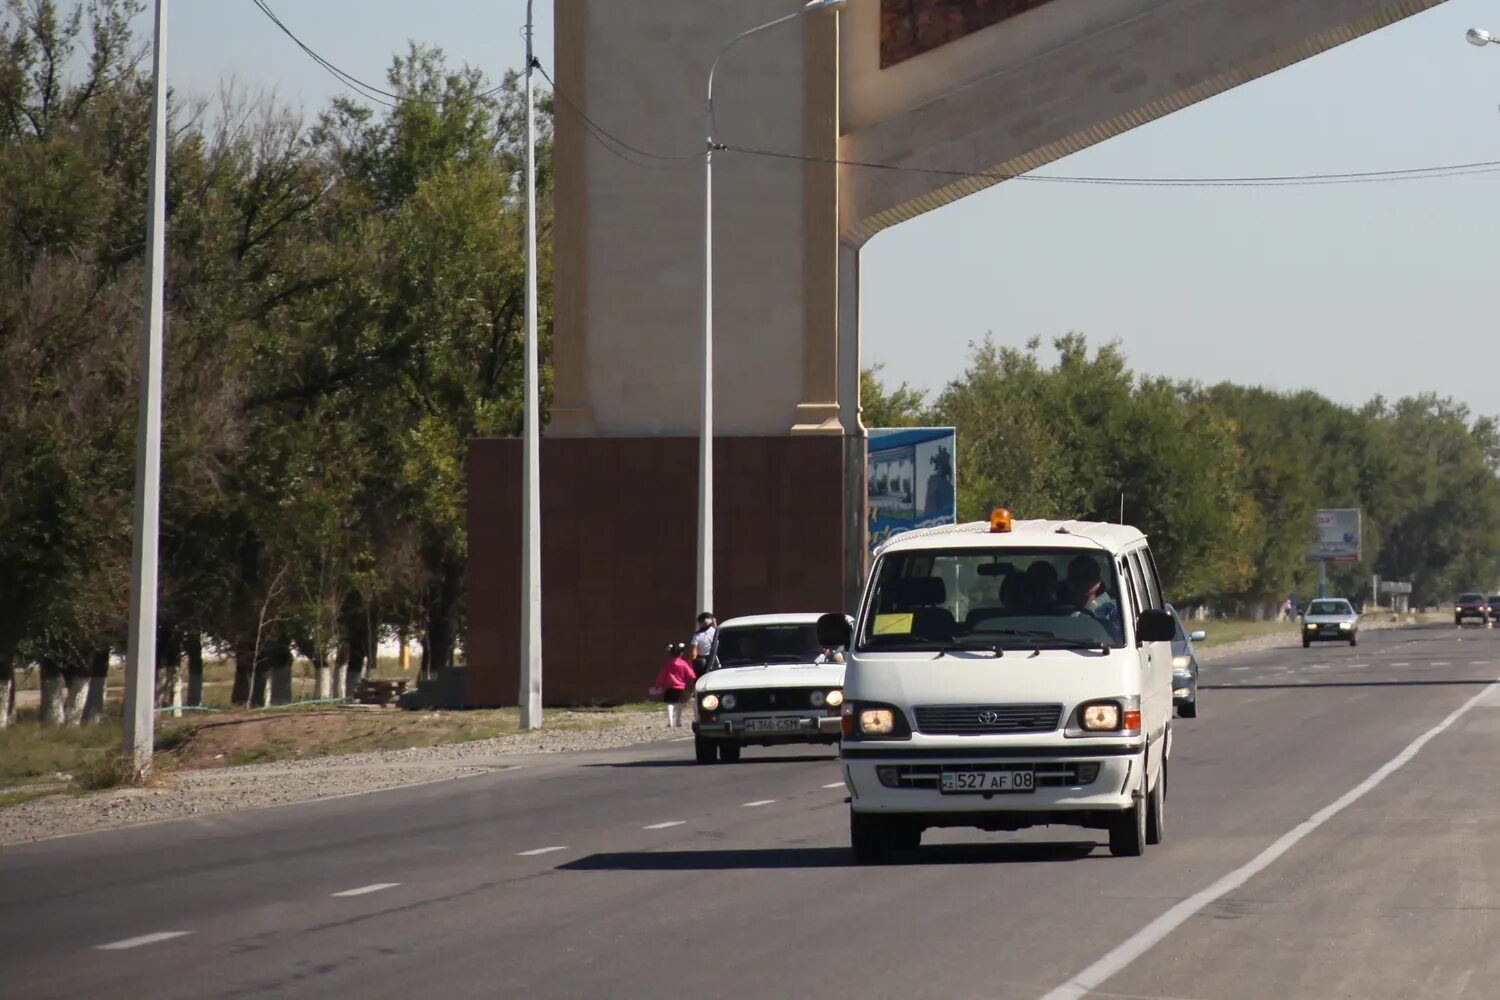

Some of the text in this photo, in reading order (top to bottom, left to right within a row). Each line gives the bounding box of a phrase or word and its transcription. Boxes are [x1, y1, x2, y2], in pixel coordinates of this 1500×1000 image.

[957, 772, 1033, 788] 527 AF 08
